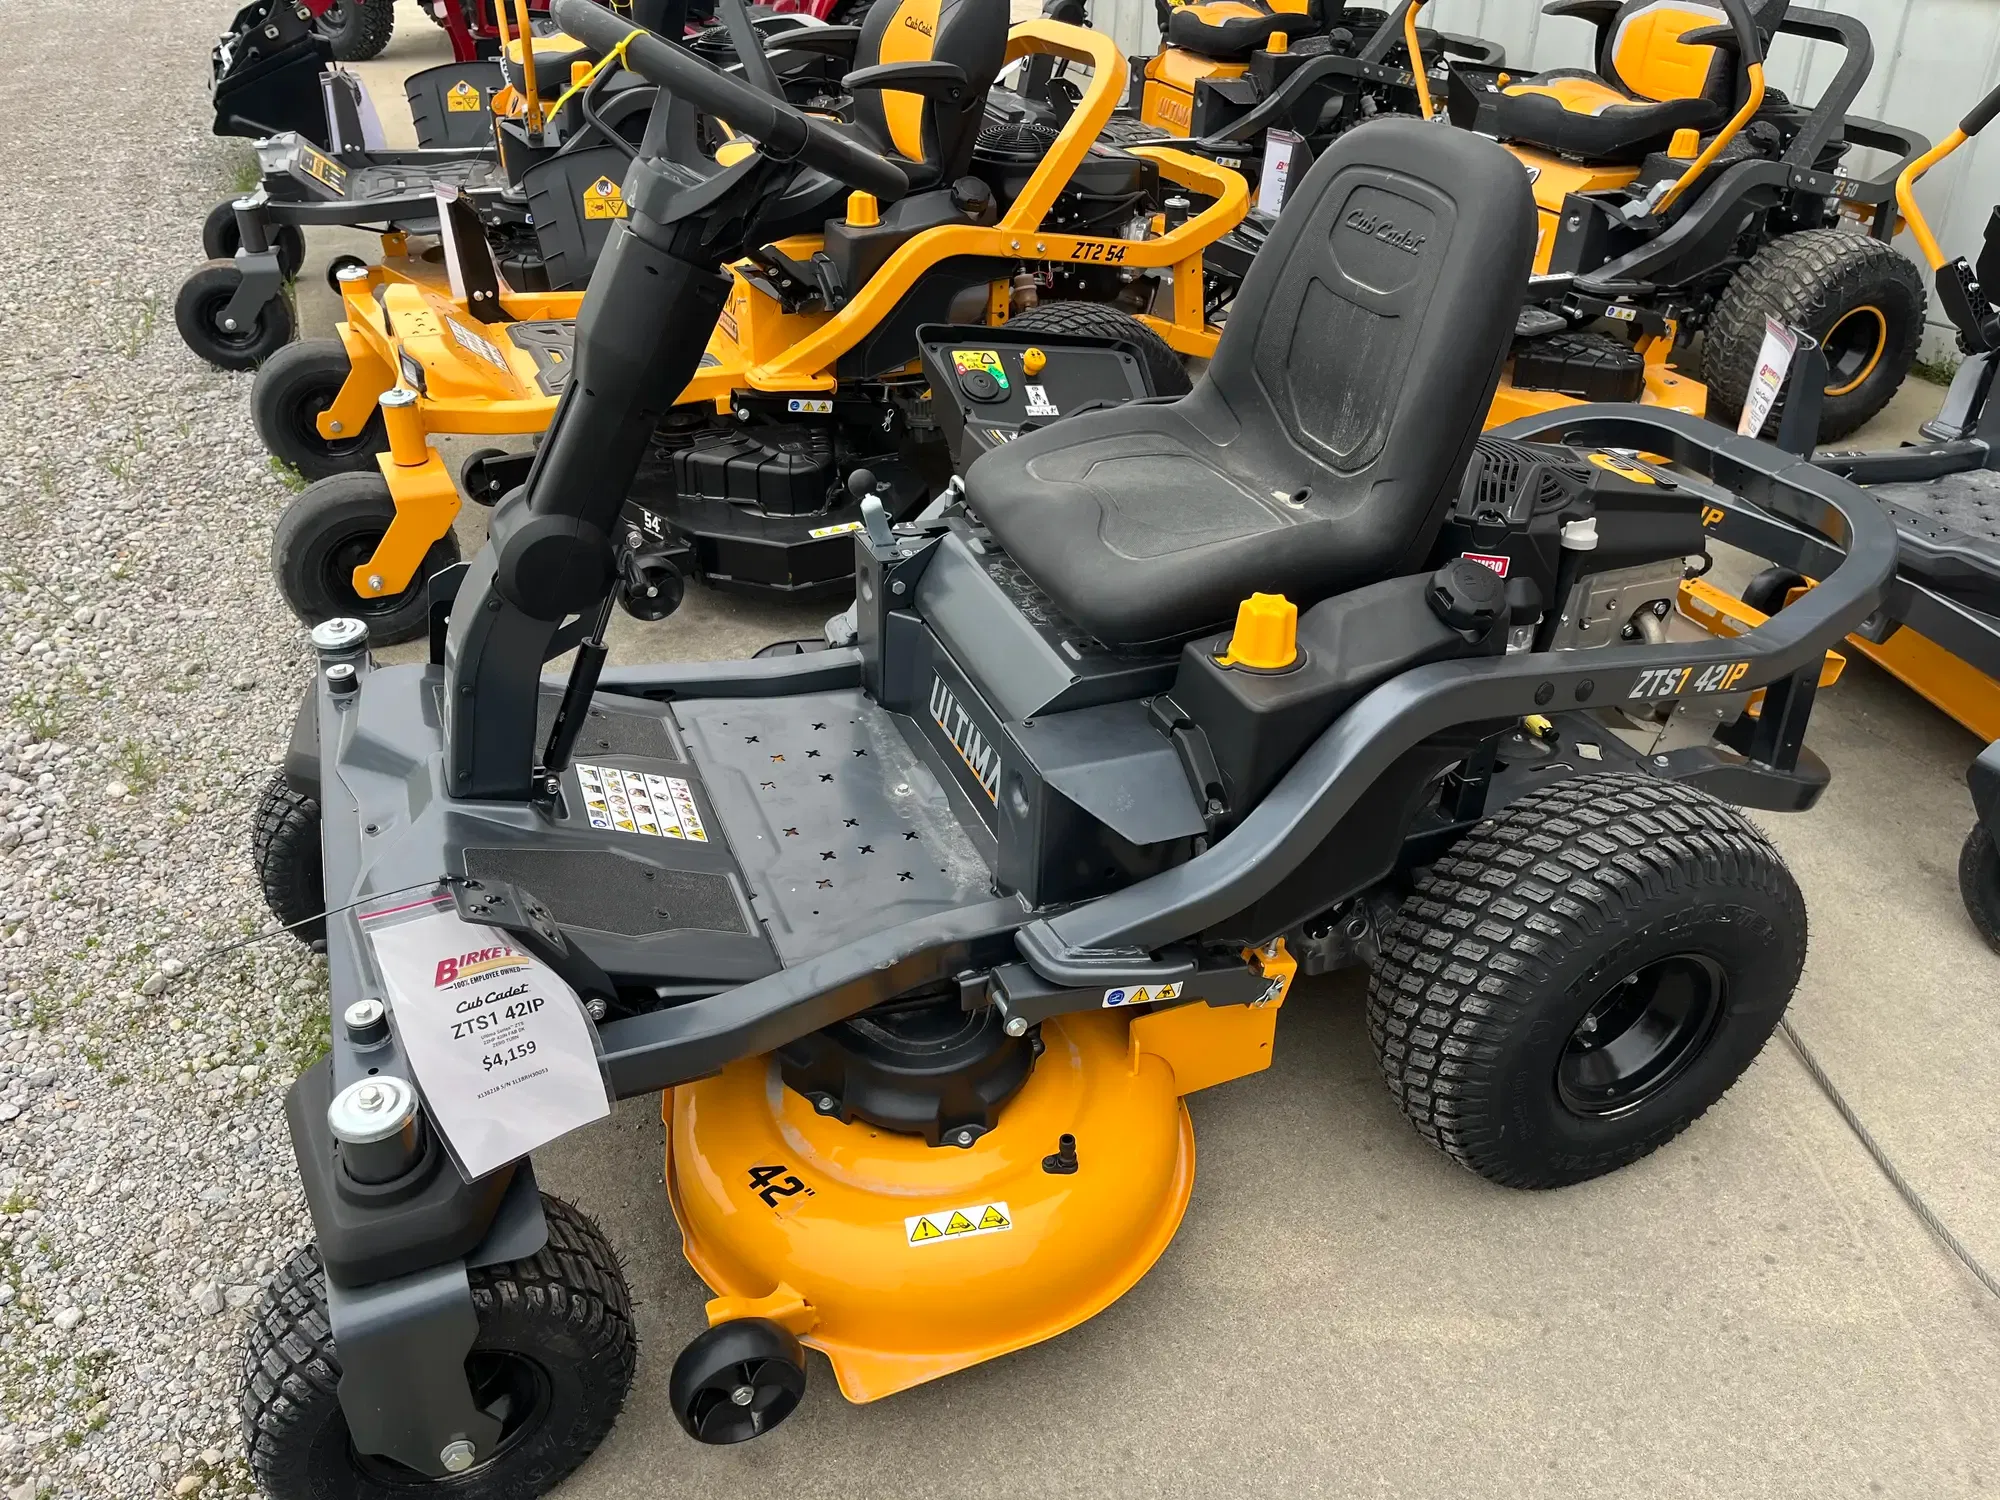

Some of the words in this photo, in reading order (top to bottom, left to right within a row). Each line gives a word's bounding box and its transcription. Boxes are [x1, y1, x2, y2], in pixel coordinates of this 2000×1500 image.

[1345, 208, 1378, 235] Cub
[1375, 220, 1426, 257] Cadet
[1071, 242, 1104, 260] ZT2
[1628, 667, 1693, 699] ZTS1
[1693, 663, 1749, 692] 42IP
[929, 675, 1002, 810] ULTIMA
[453, 978, 470, 990] 100%
[469, 971, 500, 985] EMPLOYEE
[499, 966, 521, 976] OWNED
[456, 996, 483, 1014] Cub
[484, 983, 530, 1004] Cadet
[450, 1011, 499, 1040] ZTS1
[505, 998, 545, 1019] 42IP
[482, 1040, 537, 1072] $4,159
